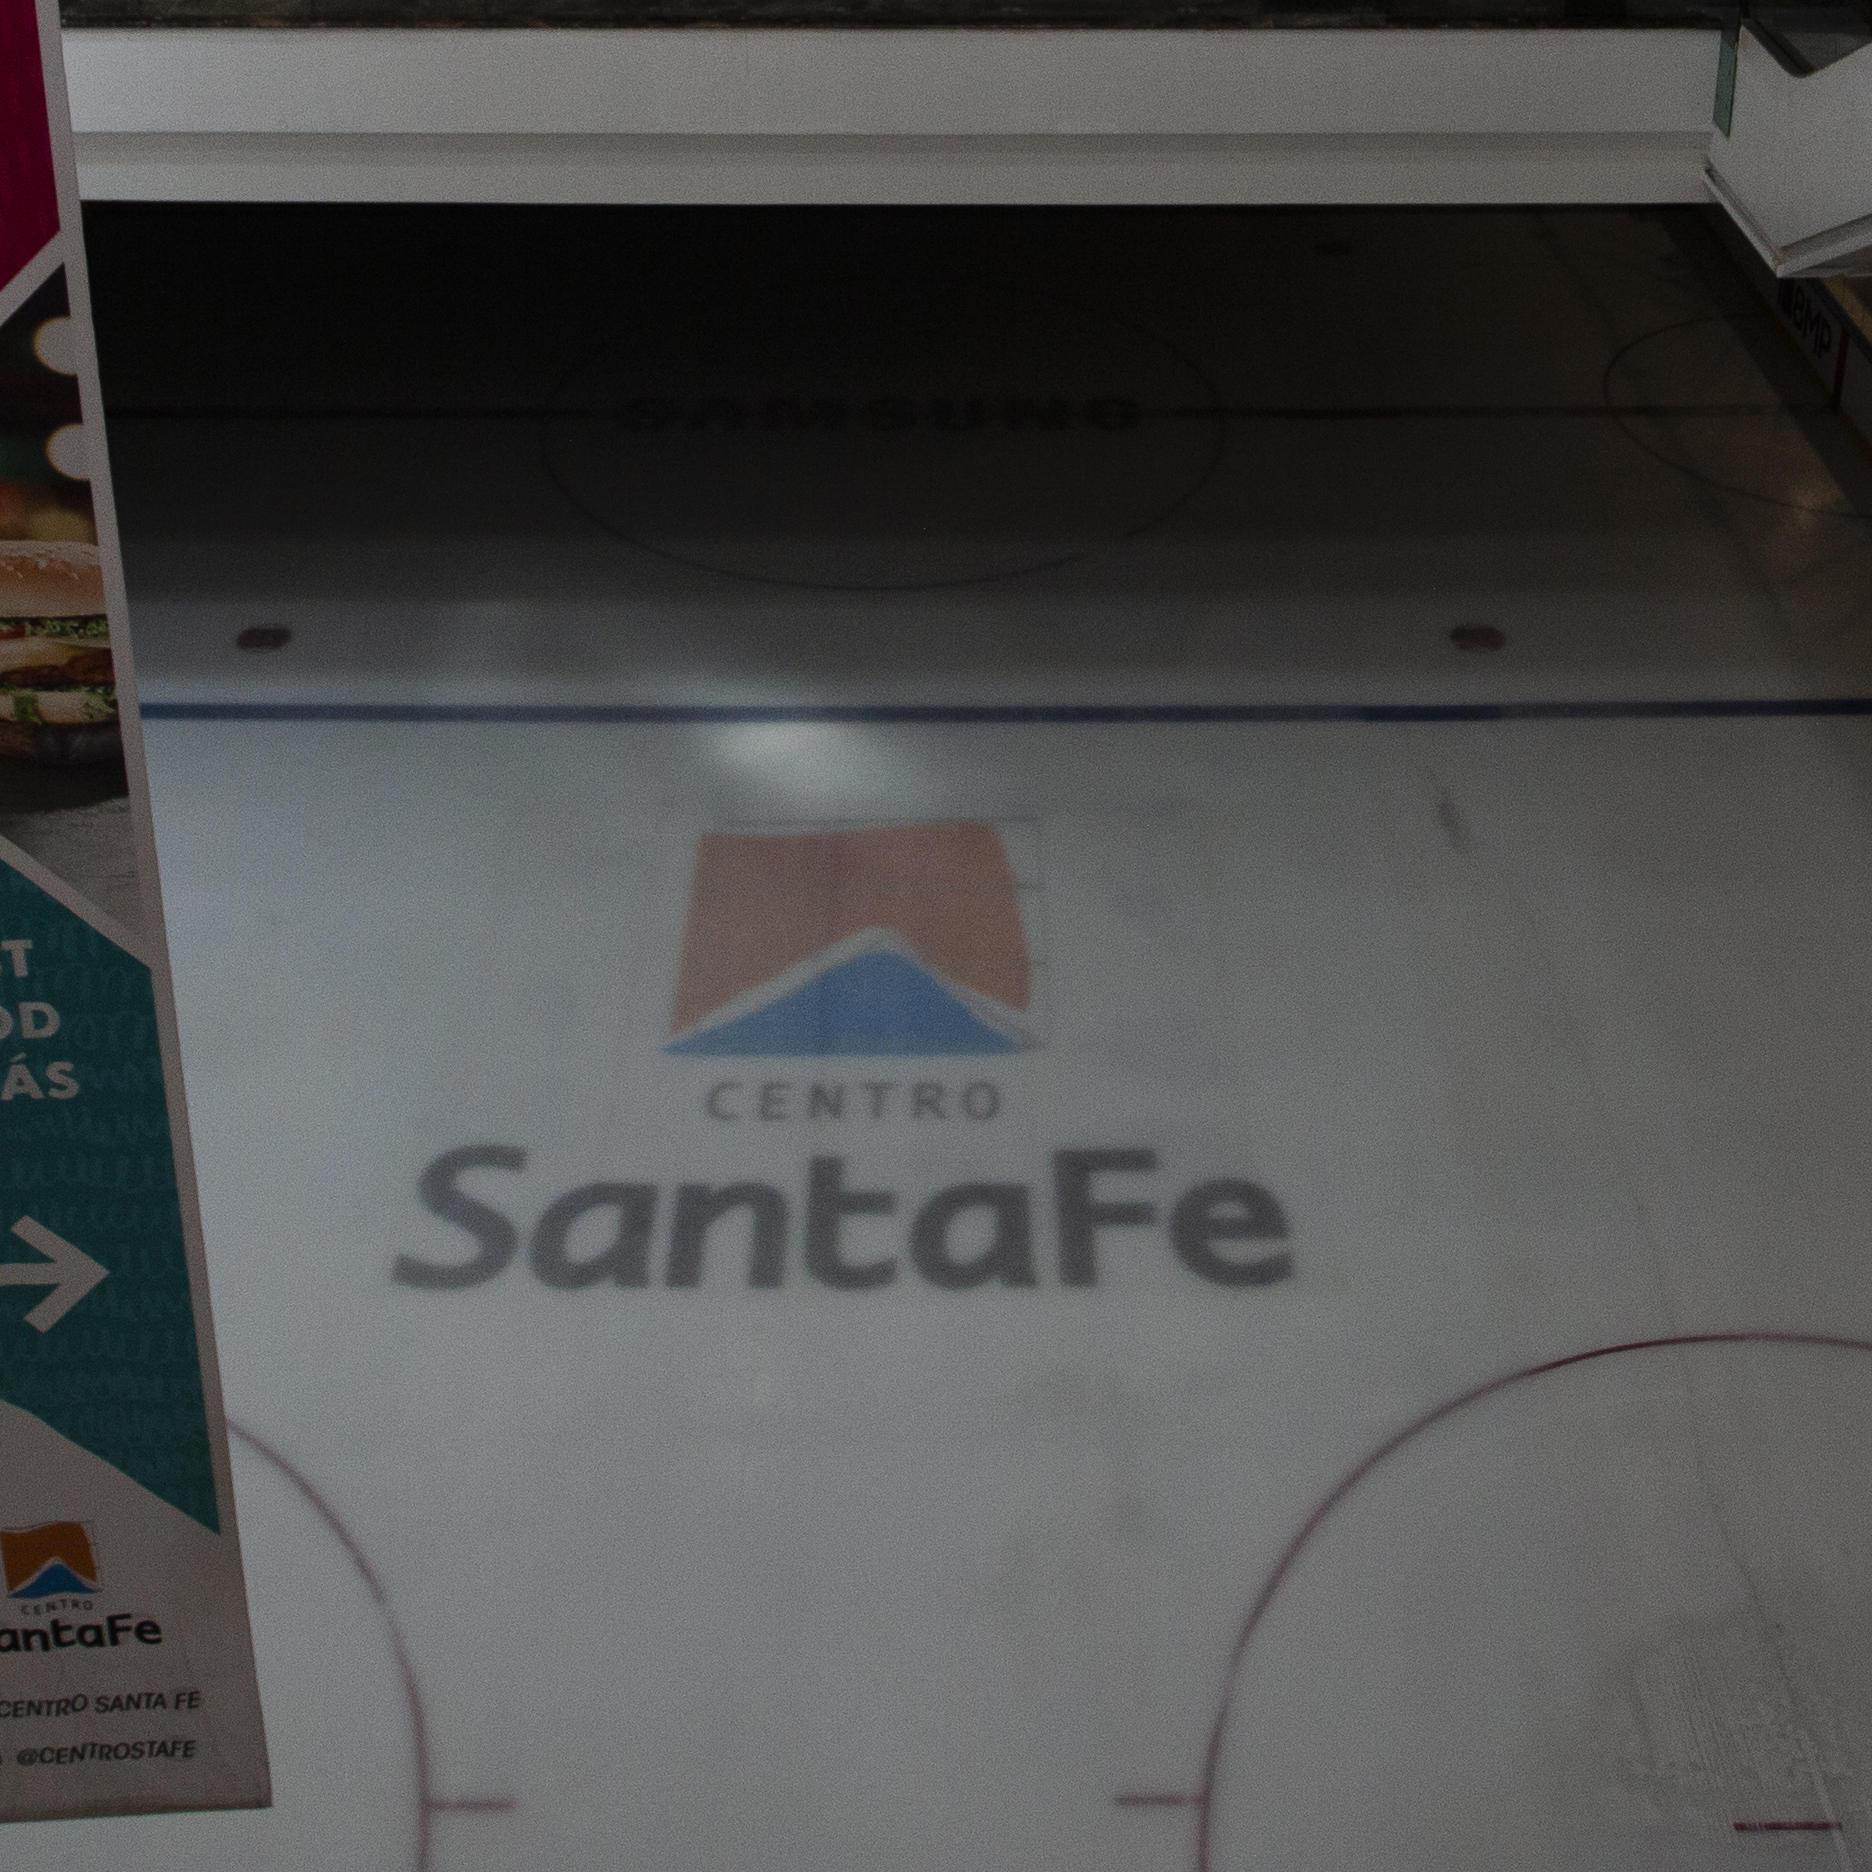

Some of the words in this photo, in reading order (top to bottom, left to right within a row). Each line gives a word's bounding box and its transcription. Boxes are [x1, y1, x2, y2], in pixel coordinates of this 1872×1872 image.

[705, 1080, 1001, 1123] CENTRO
[391, 1143, 1294, 1291] SantaFe
[20, 1598, 94, 1616] CENTRO
[95, 1692, 166, 1713] SANTA
[174, 1690, 201, 1710] FE
[17, 1739, 197, 1766] @CENTROSTAFE
